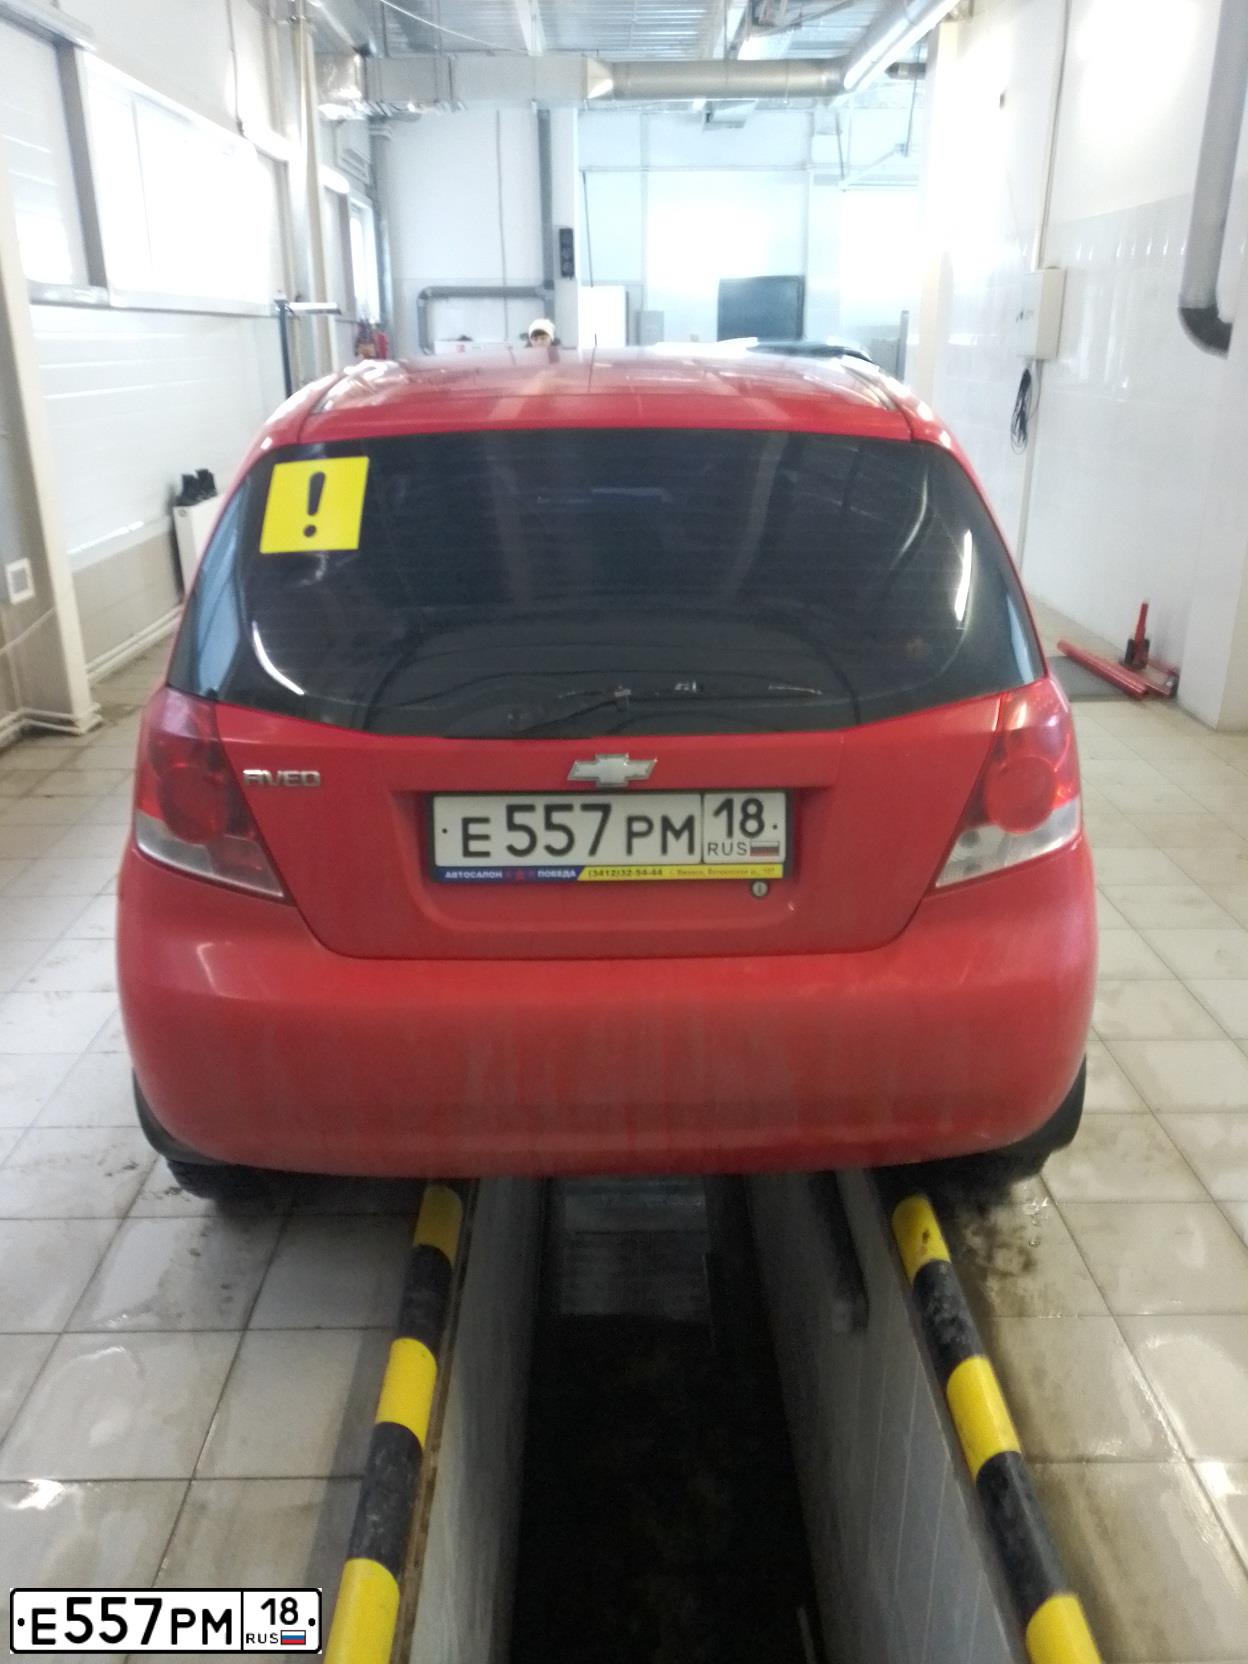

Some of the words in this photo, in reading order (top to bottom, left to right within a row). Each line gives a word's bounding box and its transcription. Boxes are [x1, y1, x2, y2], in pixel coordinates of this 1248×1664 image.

[242, 769, 321, 788] AVEO
[713, 797, 765, 839] 18
[707, 841, 748, 856] RUS
[444, 870, 503, 879] АВТОСАЛОН
